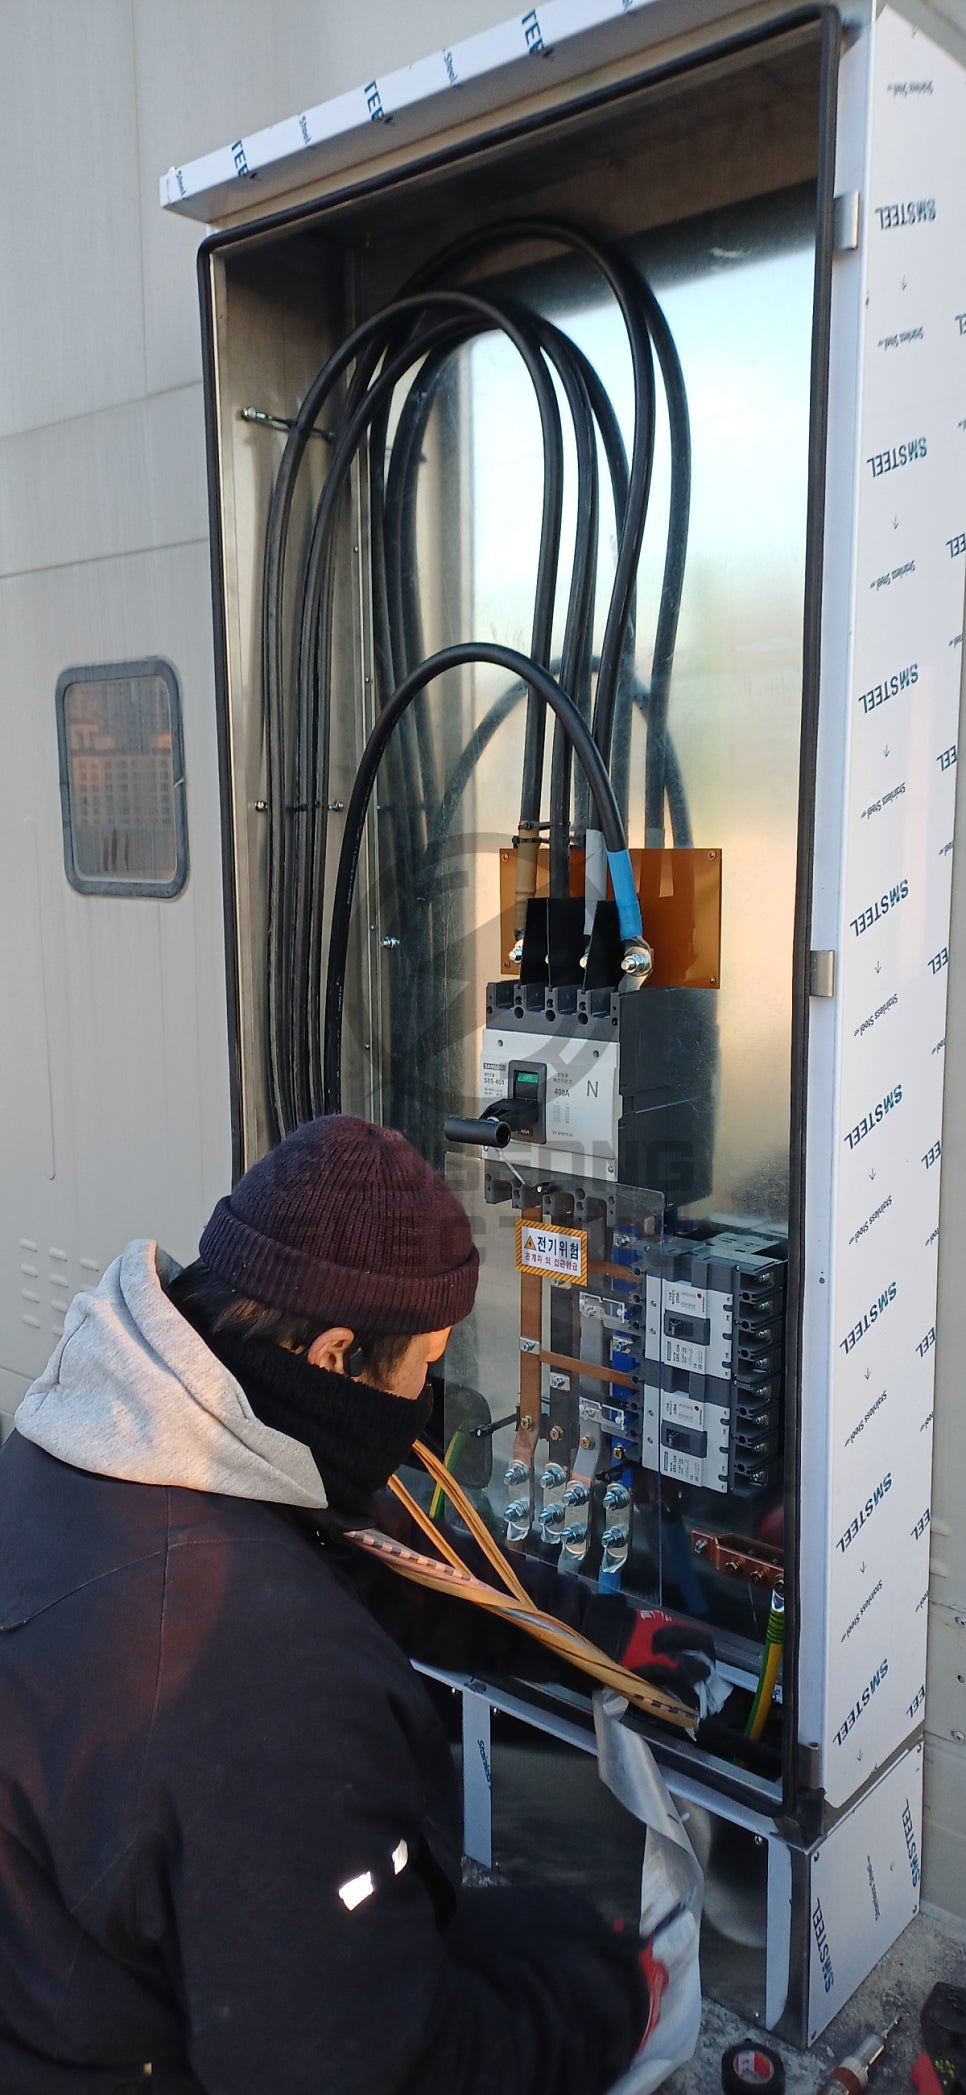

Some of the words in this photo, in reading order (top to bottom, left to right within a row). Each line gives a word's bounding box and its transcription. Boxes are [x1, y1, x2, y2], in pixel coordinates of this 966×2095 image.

[874, 199, 937, 230] SMSTEEL
[867, 437, 928, 478] SMSTEEL
[858, 663, 919, 714] SMSTEEL
[881, 782, 906, 805] Stainless
[867, 800, 882, 820] Steel
[850, 879, 909, 937] SMSTEEL
[874, 993, 898, 1020] Stainless
[860, 1015, 875, 1036] Steel
[587, 1079, 599, 1097] N
[844, 1084, 903, 1150] SMSTEEL
[869, 1195, 892, 1225] Stainless
[854, 1221, 869, 1243] Steel
[525, 1252, 543, 1264] 관계자
[537, 1236, 579, 1260] 전기위험
[839, 1282, 897, 1355] SMSTEEL
[864, 1390, 887, 1423] Stainless
[849, 1420, 865, 1444] Steel
[836, 1472, 893, 1553] SMSTEEL
[860, 1580, 882, 1615] Stainless
[846, 1613, 861, 1639] Steel
[833, 1659, 889, 1746] SMSTEEL
[902, 1798, 920, 1888] SMSTEEL
[812, 1897, 836, 1994] SMSTEEL
